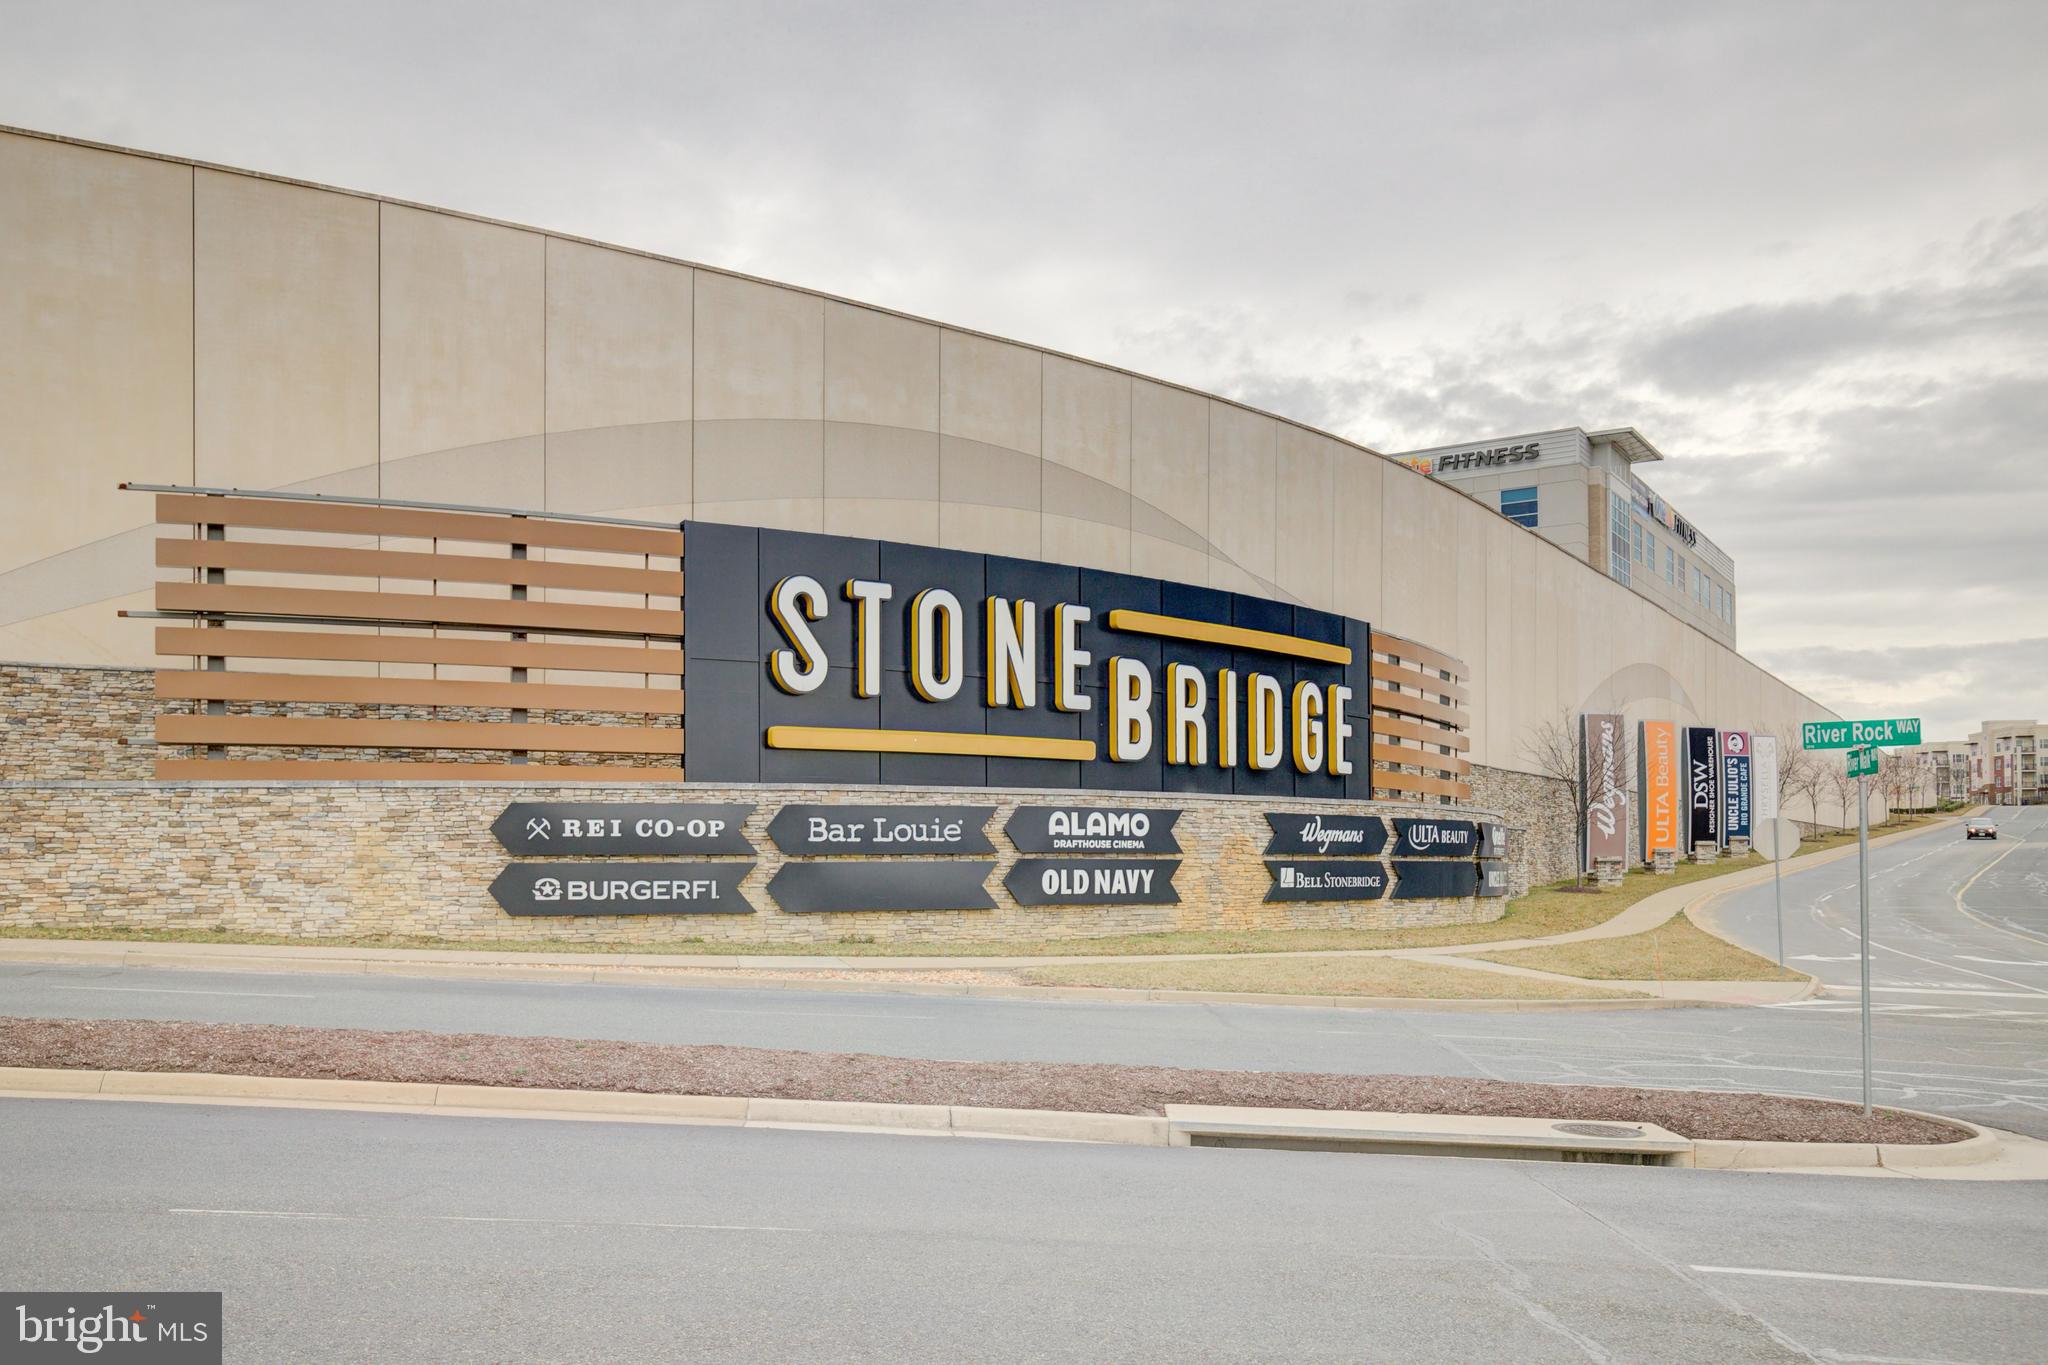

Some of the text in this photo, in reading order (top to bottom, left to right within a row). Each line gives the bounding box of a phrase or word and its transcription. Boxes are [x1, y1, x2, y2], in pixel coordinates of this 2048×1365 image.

[1438, 442, 1540, 472] FITNESS
[771, 575, 1092, 714] STONE
[1107, 654, 1353, 776] BRIDGE
[1805, 719, 1919, 743] River Rock WAY
[1707, 736, 1715, 779] WAREHOUSE
[1588, 720, 1625, 840] Wegmans
[1656, 727, 1671, 843] ULTA Beauty
[1693, 758, 1708, 810] DSW
[1727, 757, 1739, 831] UNCLE JULIO'S
[1740, 762, 1748, 826] RIO GRANDE CAFE
[562, 819, 725, 838] REI CO-OP
[808, 817, 963, 842] Bar Louie
[1048, 811, 1150, 837] ALAMO
[1300, 815, 1365, 854] Wegmans
[1411, 824, 1469, 844] ULTA BEAUTY
[1053, 839, 1145, 849] DRAFTHOUSE CINEMA
[1041, 869, 1155, 896] OLD NAVY
